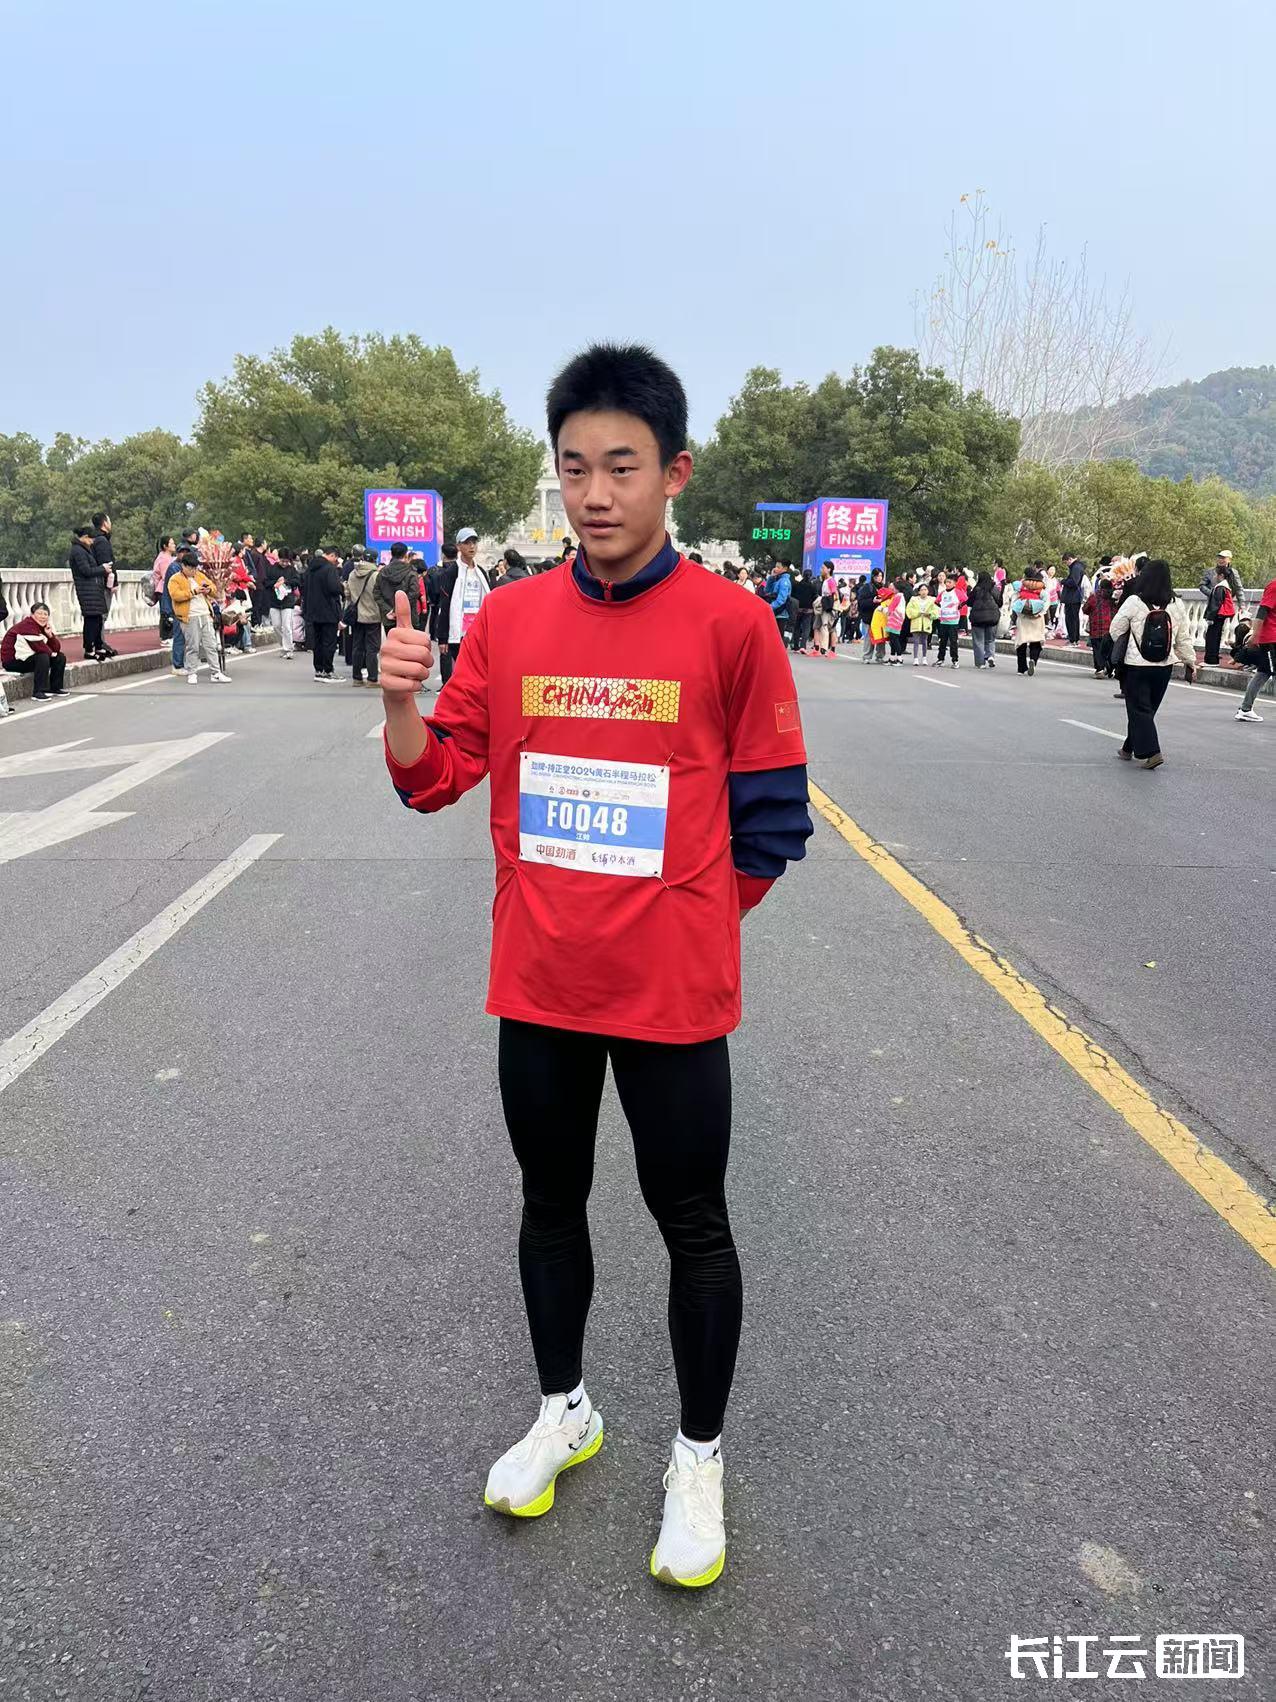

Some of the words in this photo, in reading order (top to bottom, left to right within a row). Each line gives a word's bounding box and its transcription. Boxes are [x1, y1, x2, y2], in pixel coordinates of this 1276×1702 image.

[374, 495, 428, 524] 终点
[826, 505, 879, 532] 终点
[378, 525, 425, 537] FINISH
[829, 533, 875, 546] FINISH
[543, 681, 610, 711] CHINA
[546, 800, 628, 836] F0048
[536, 843, 577, 861] 中国劲酒
